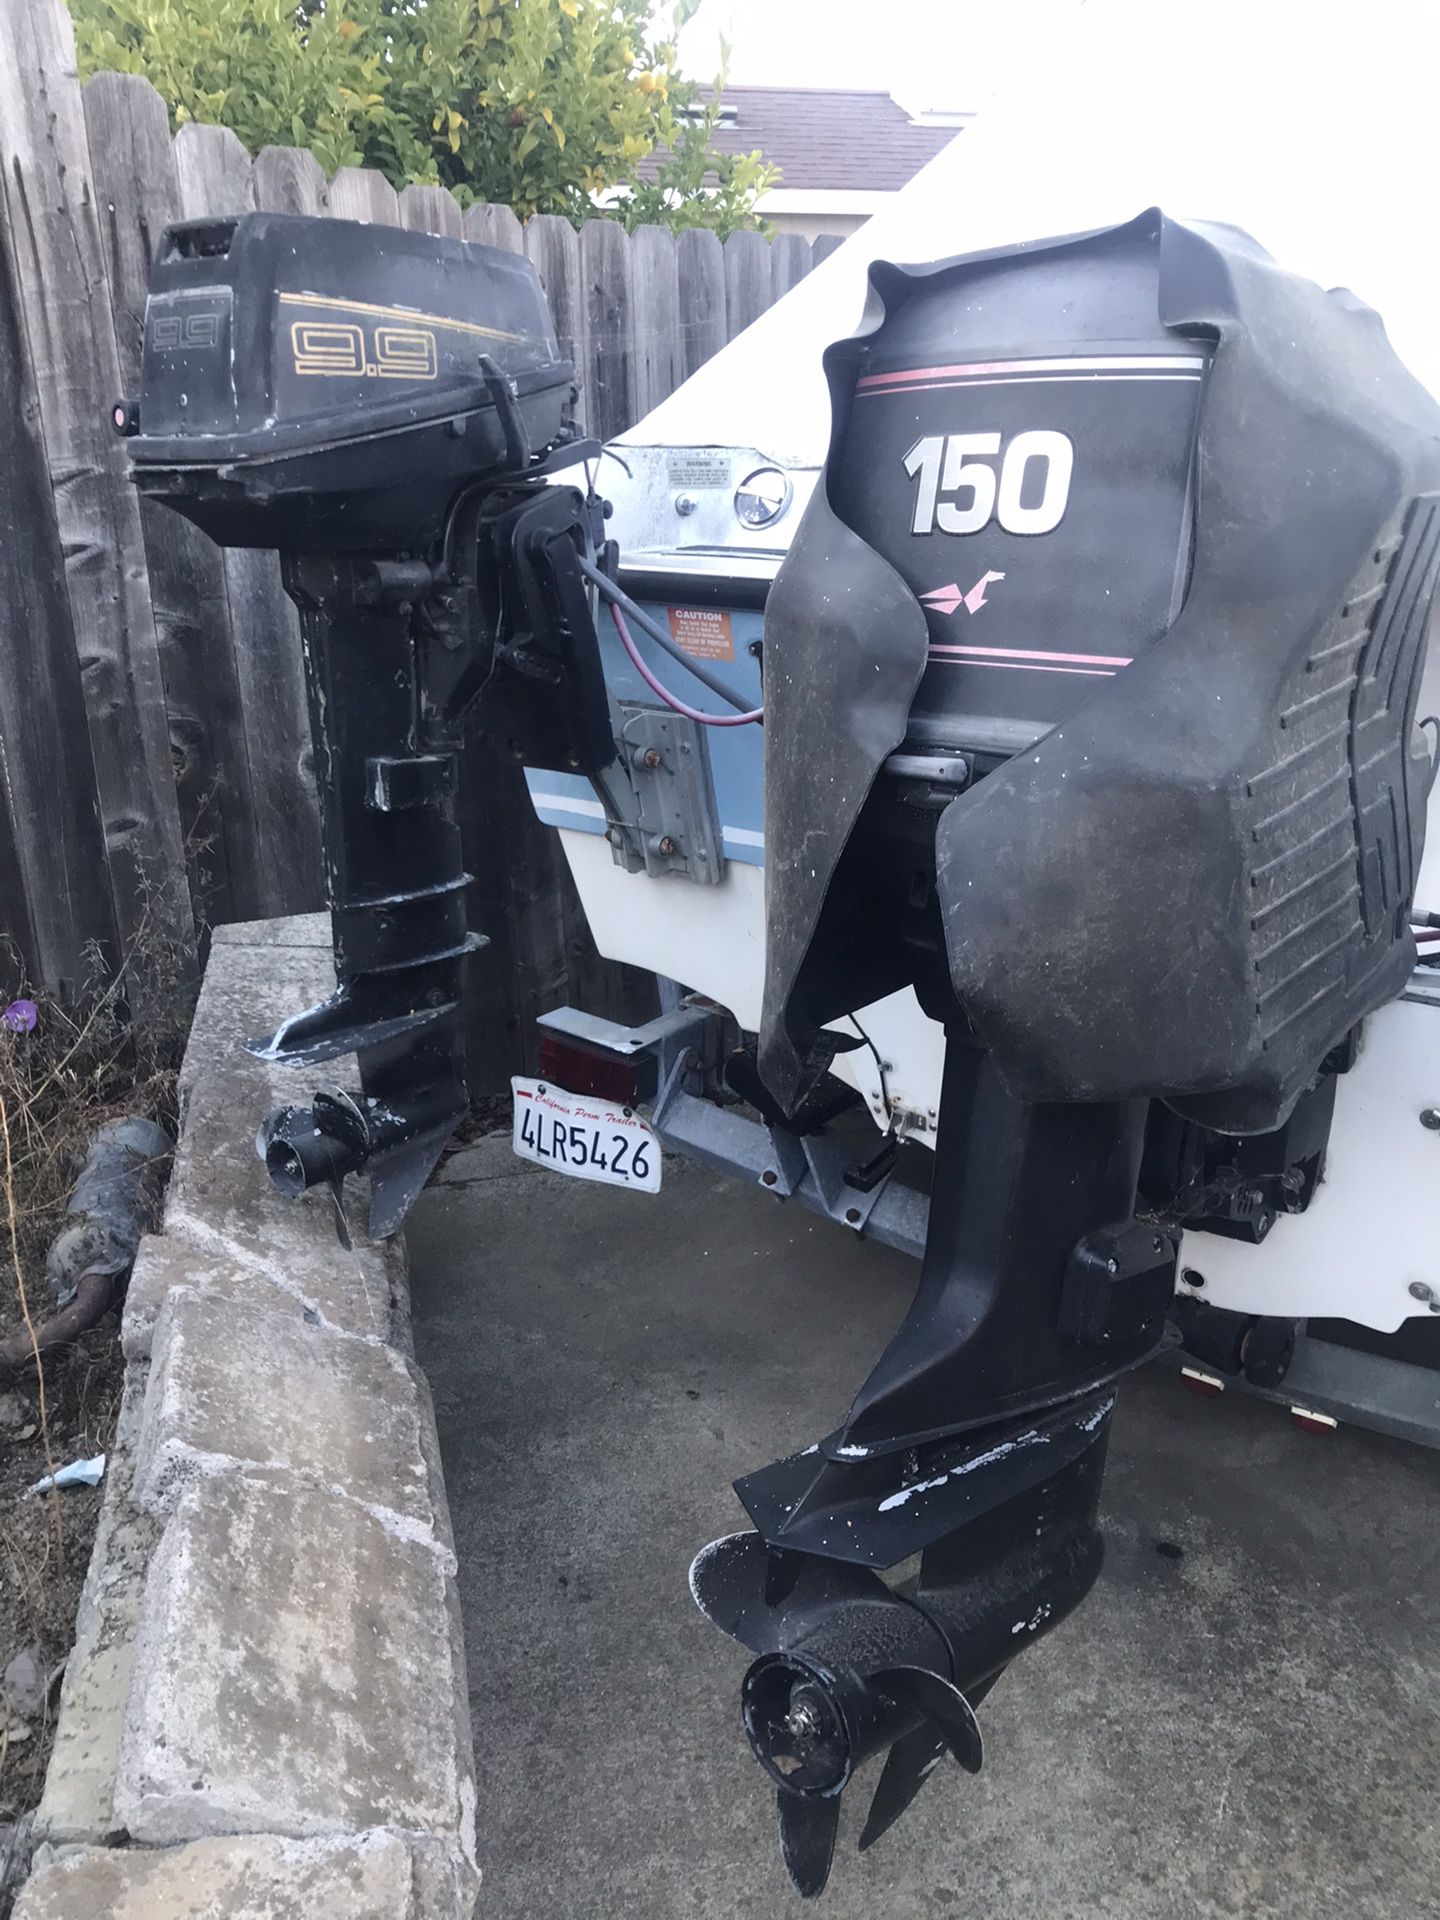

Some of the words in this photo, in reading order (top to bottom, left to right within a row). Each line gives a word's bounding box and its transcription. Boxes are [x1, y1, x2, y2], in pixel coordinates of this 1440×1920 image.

[290, 321, 438, 380] 9.9
[902, 430, 1074, 536] 150
[675, 610, 722, 621] CAUTION
[535, 1094, 571, 1115] California
[574, 1108, 600, 1121] Perm
[605, 1112, 638, 1127] Trailer
[521, 1108, 650, 1179] 4LR5426
